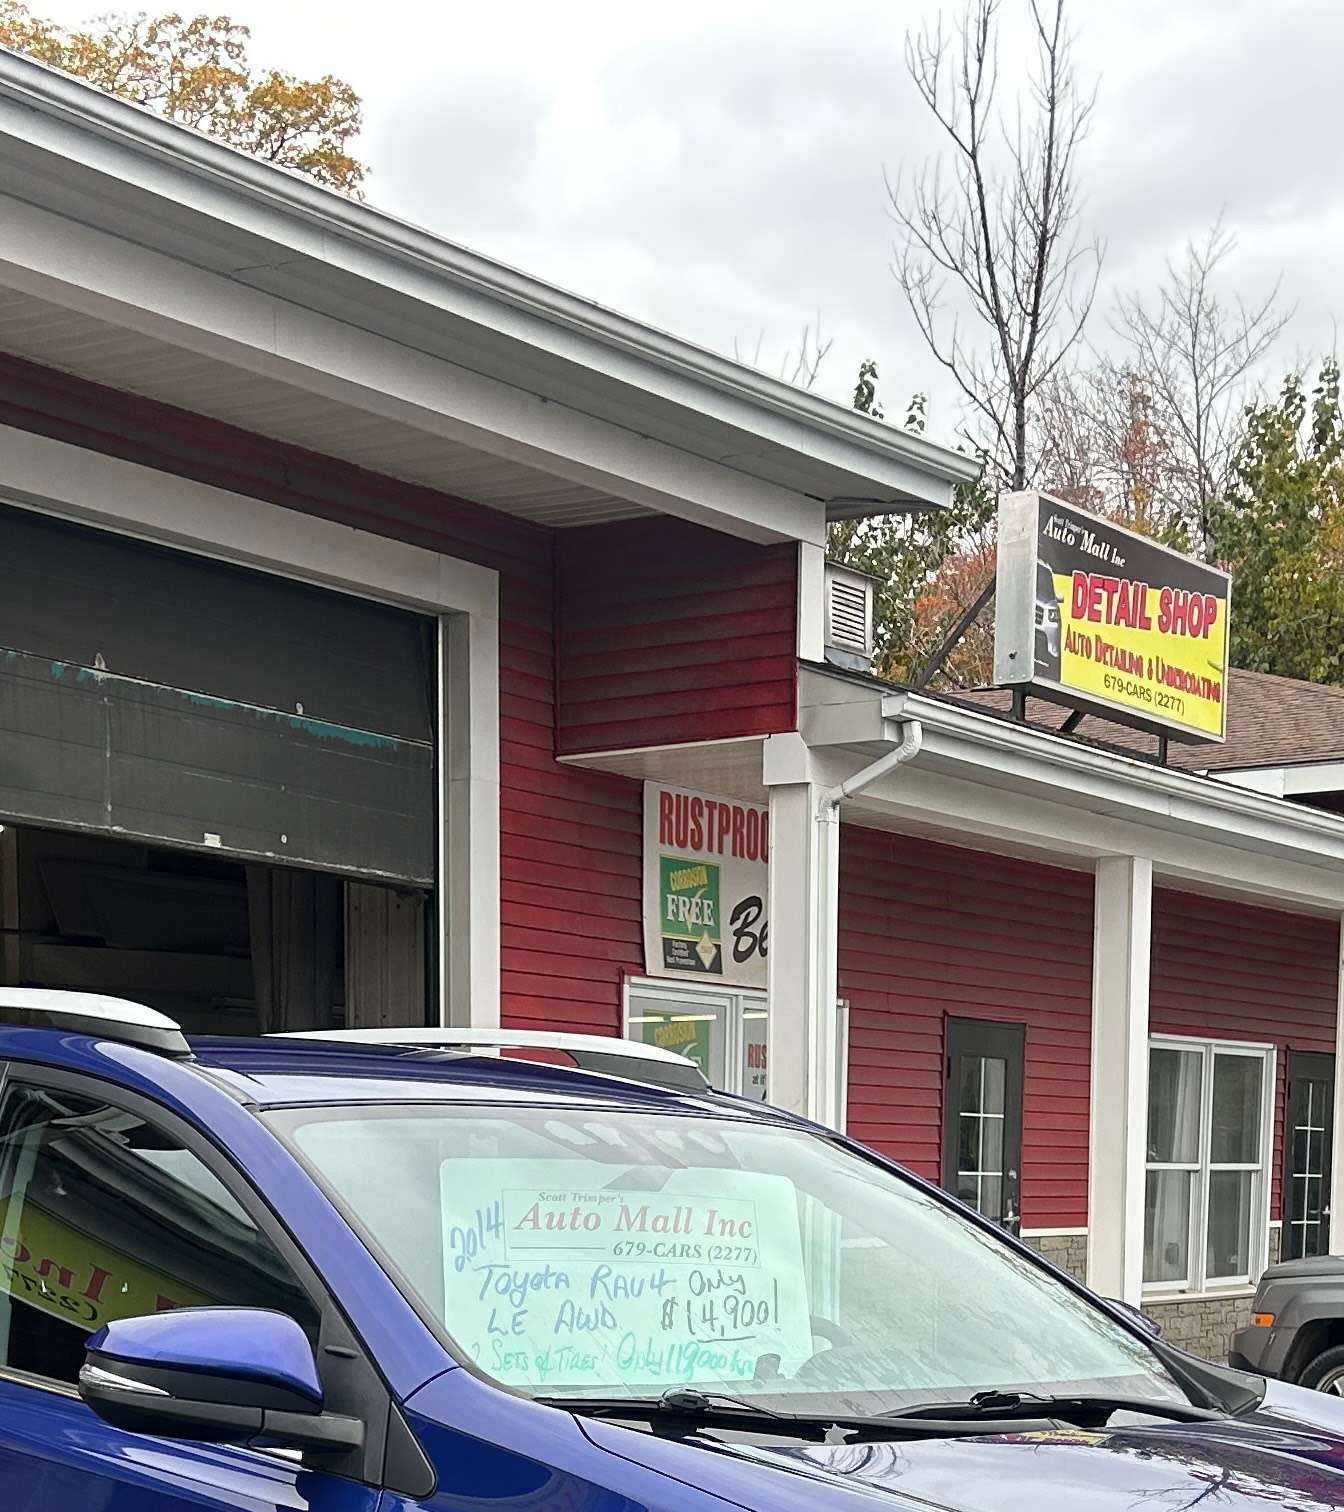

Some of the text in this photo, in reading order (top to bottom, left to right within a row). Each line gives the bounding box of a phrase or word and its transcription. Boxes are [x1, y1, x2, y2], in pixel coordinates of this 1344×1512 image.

[1043, 515, 1076, 546] Auto
[1080, 529, 1110, 561] Mall
[1110, 547, 1126, 567] Inc
[1071, 569, 1218, 640] DETAIL SHOP
[1103, 673, 1185, 716] 679-CARS (2277)
[666, 893, 715, 927] FREE
[538, 1191, 624, 1206] Scott Trimper's
[449, 1200, 505, 1273] 2014
[513, 1202, 753, 1239] Auto Mall Inc
[612, 1240, 758, 1266] 679-CARS (2277)
[688, 1268, 747, 1297] Only
[487, 1308, 529, 1335] LE
